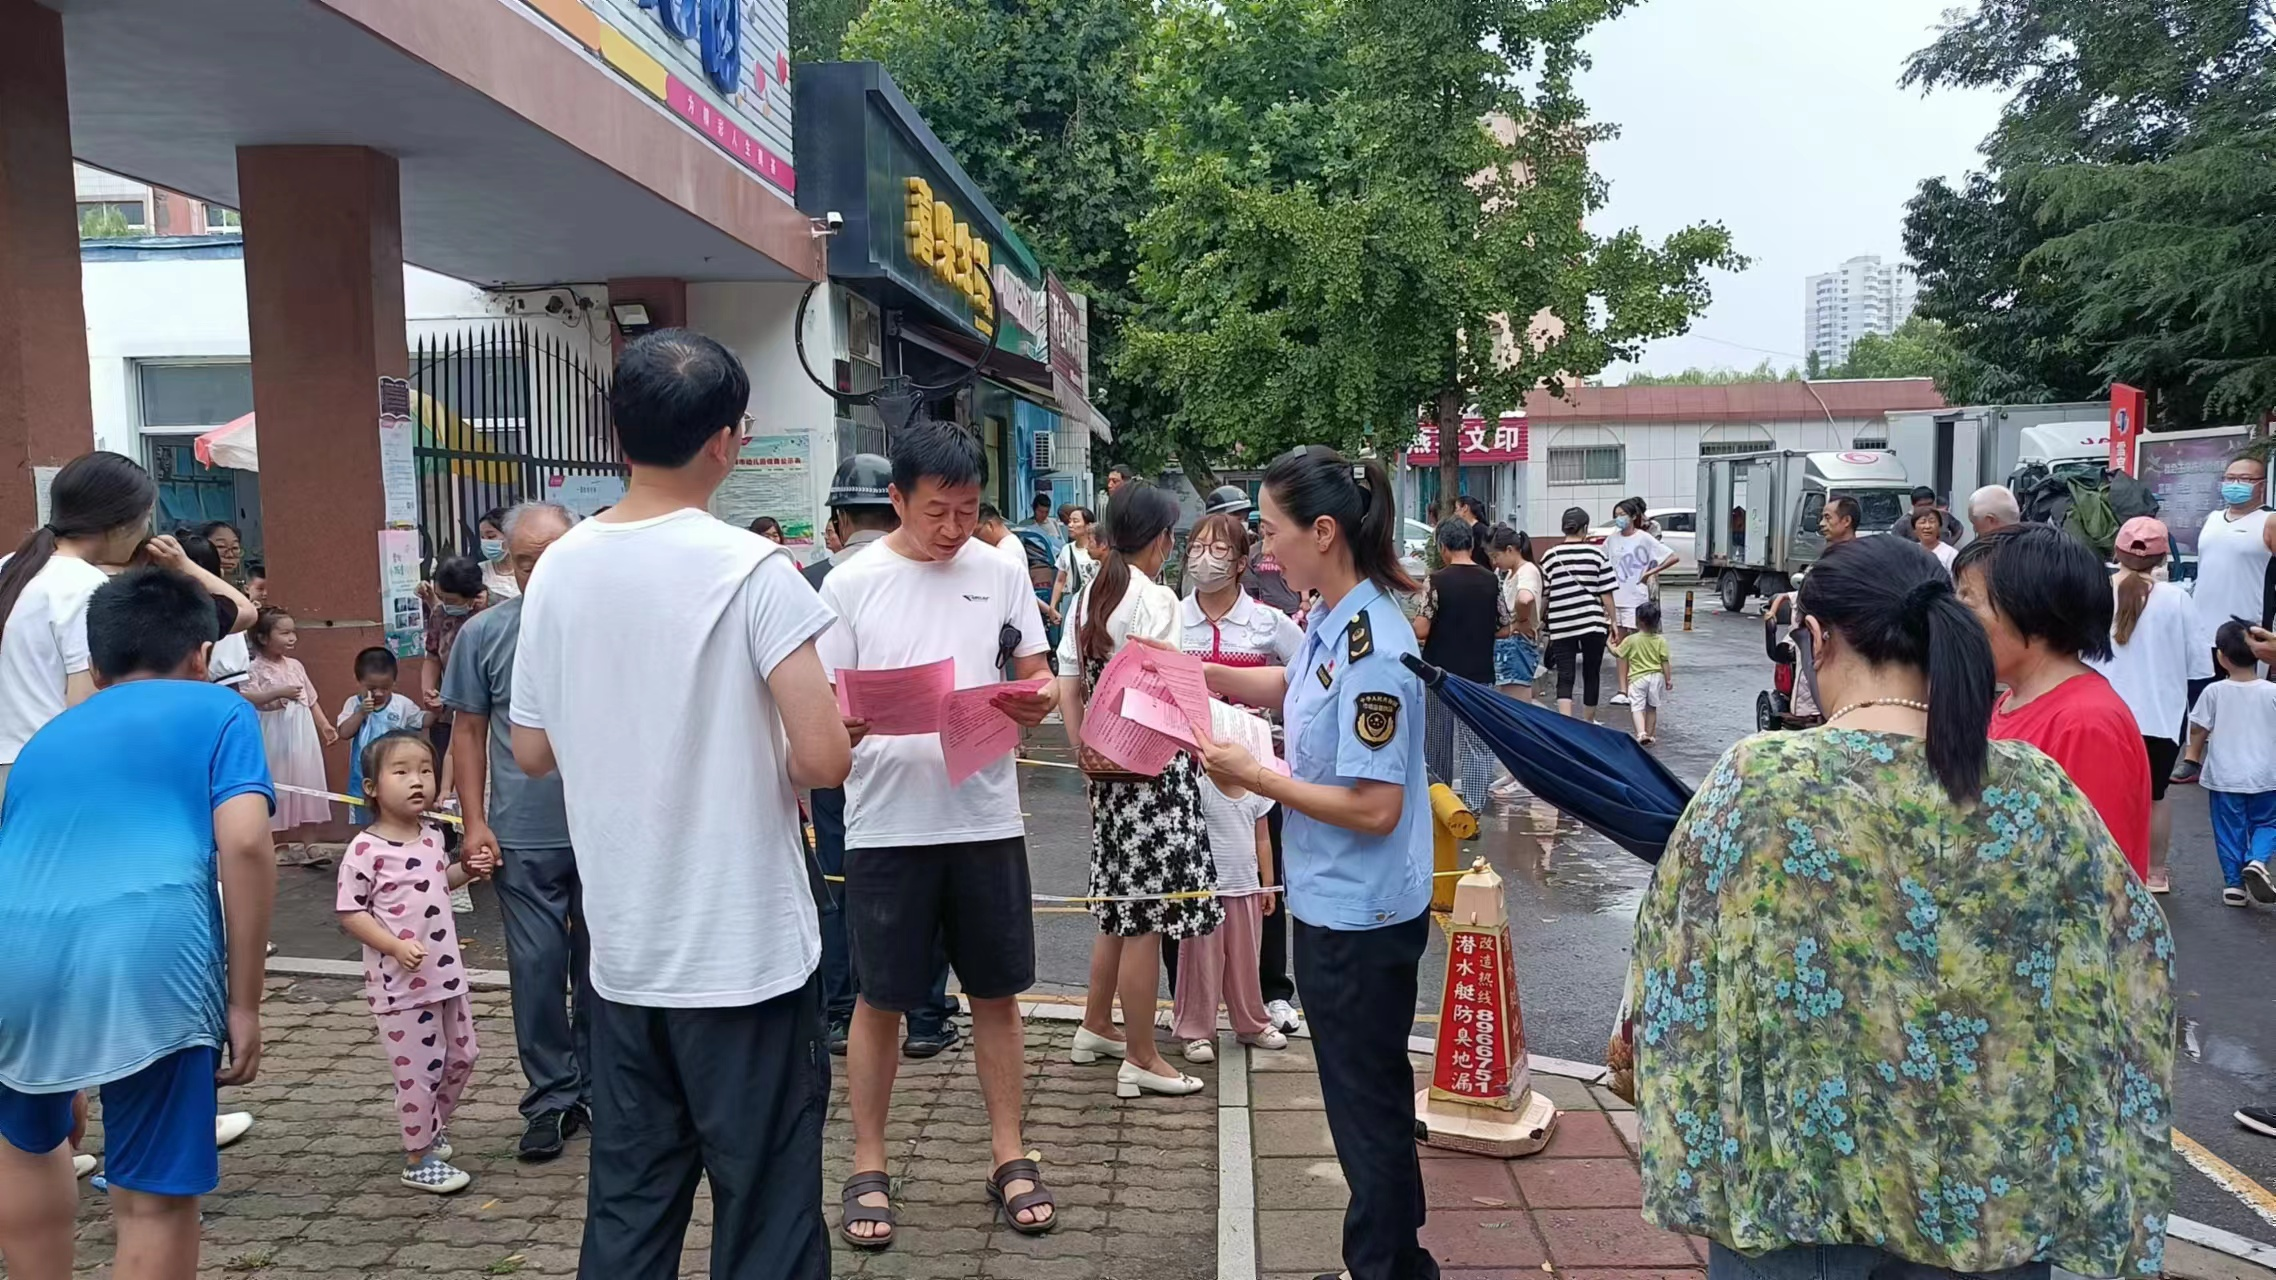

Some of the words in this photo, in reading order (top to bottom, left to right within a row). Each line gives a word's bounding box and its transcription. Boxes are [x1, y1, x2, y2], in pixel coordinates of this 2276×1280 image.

[1406, 426, 1519, 454] 燕文印
[1477, 936, 1495, 1006] 改造热线
[1450, 934, 1476, 1093] 潜水艇防臭地漏
[1475, 1009, 1495, 1093] 8966751
